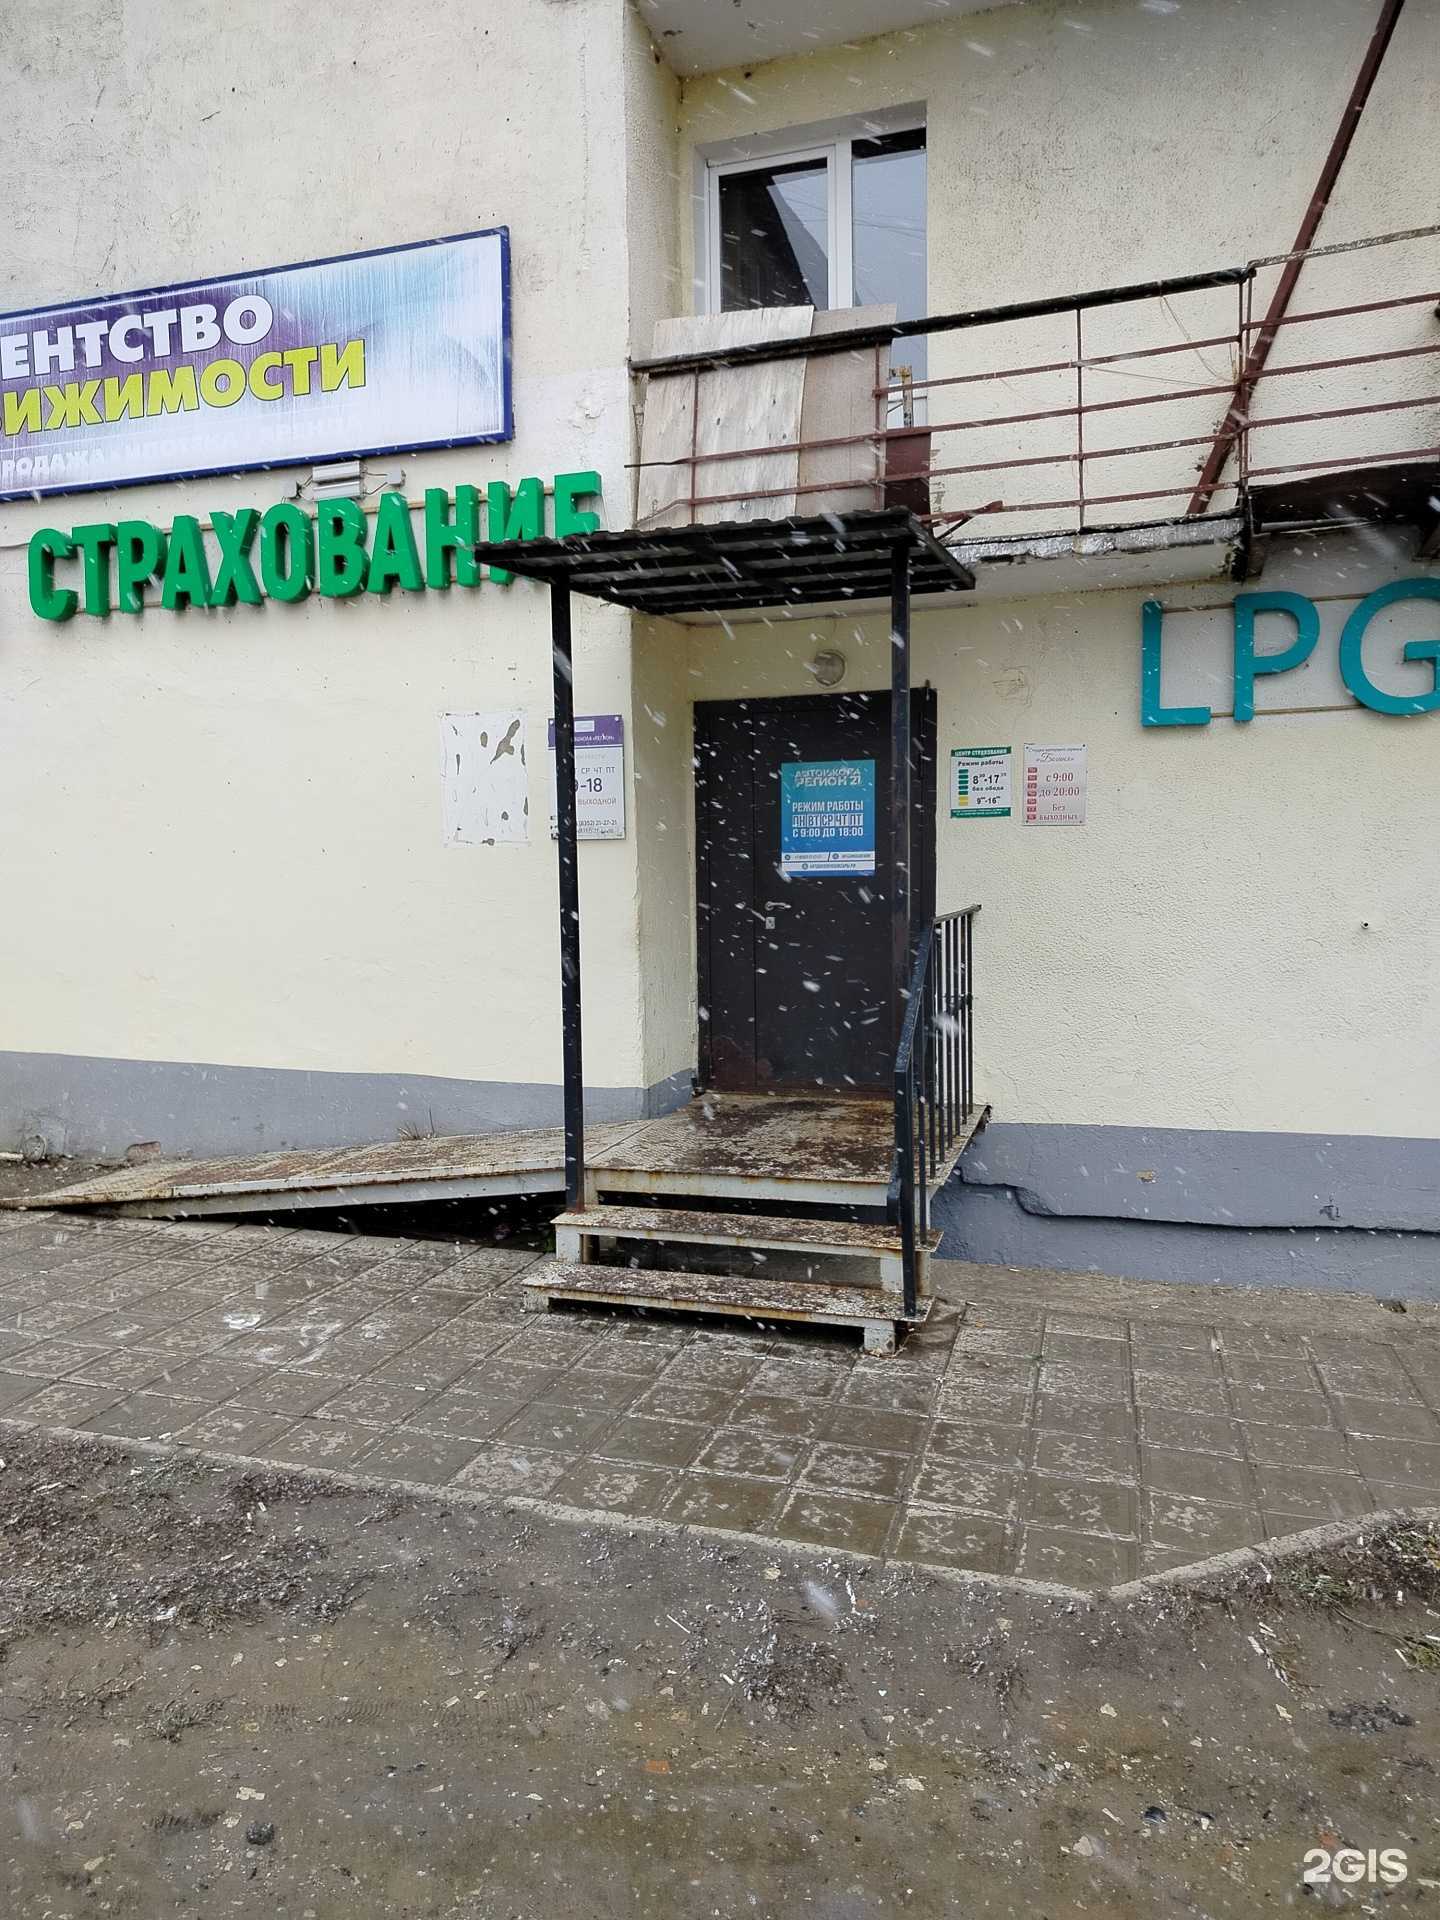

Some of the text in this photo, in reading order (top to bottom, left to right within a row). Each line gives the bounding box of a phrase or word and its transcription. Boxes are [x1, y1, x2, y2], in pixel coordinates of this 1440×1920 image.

[0, 294, 273, 380] ЕНТСТВО
[28, 471, 601, 622] СТРАХОВАНИЕ
[1141, 577, 1440, 727] LPG
[981, 759, 1004, 767] работы
[581, 767, 590, 775] СР
[606, 766, 616, 774] ПТ
[795, 775, 862, 788] РЕГИОН 21
[1053, 772, 1074, 782] 9:00
[1039, 786, 1080, 798] до 20:00
[792, 800, 864, 812] РЕЖИМ РАБОТЫ
[1052, 803, 1066, 812] Без
[793, 814, 863, 827] ПН ВТ СР ЧТ ПТ
[800, 828, 821, 838] 9:00
[823, 828, 836, 838] ДО
[839, 827, 864, 837] 18:00
